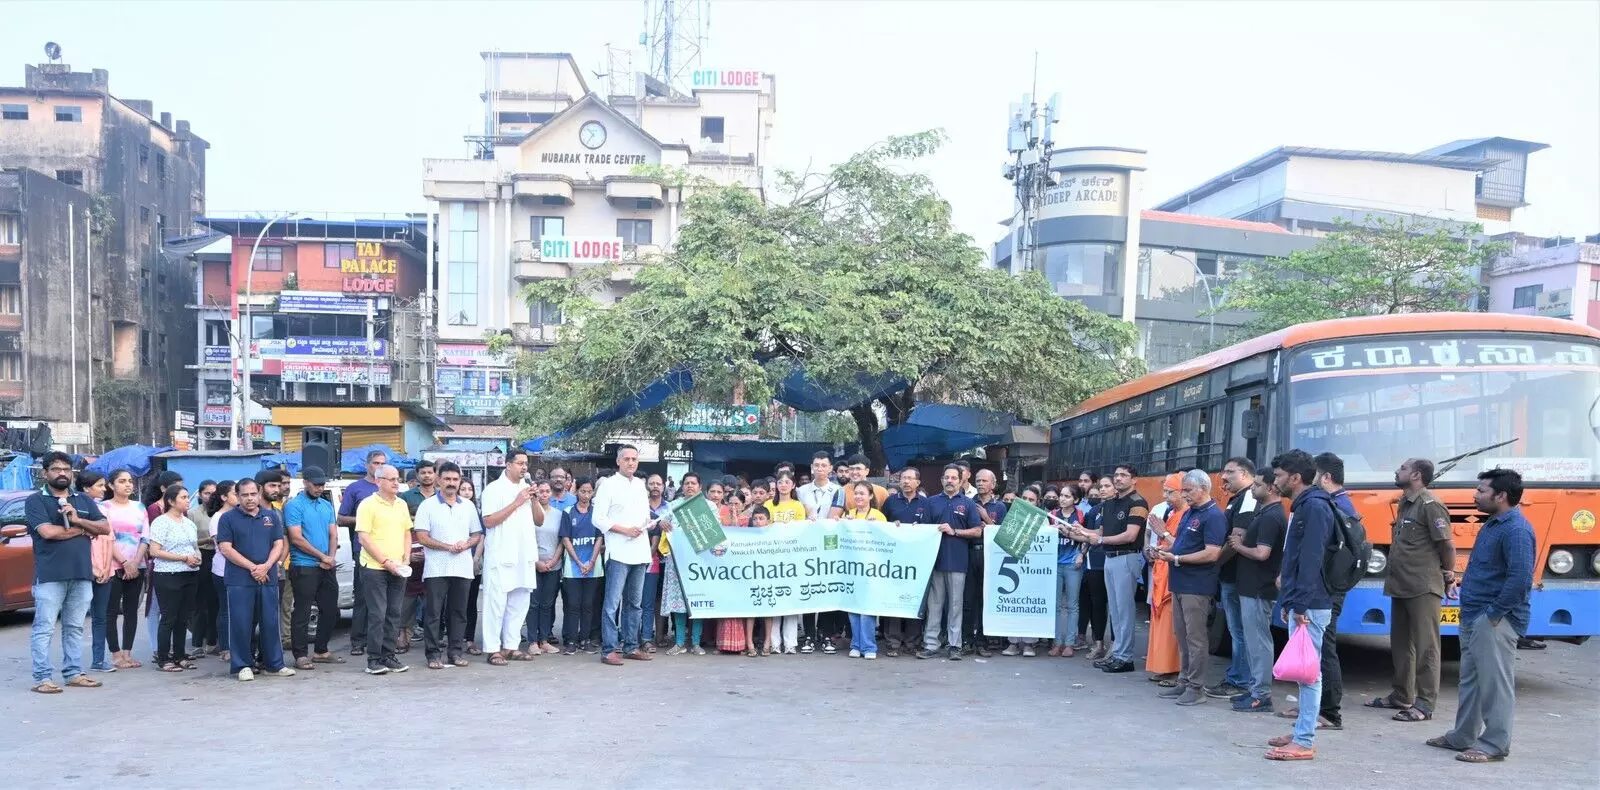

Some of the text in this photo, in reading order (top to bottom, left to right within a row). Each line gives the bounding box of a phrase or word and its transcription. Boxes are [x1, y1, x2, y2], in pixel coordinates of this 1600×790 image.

[693, 70, 759, 86] CITI LODGE
[541, 153, 646, 165] MUBARAK TRADE CENTRE
[1075, 189, 1118, 202] ARCADE
[356, 240, 381, 257] TAJ
[543, 240, 620, 258] CITI LODGE
[341, 258, 396, 274] PALACE
[342, 276, 394, 293] LODGE
[572, 537, 595, 546] NIPT
[1033, 535, 1051, 544] 024
[1060, 537, 1075, 546] IPT
[1030, 544, 1045, 552] AY
[688, 557, 918, 582] Swacchata Shramadan
[1020, 566, 1053, 575] Month
[750, 581, 855, 608] ಸ್ವಚ್ಛತಾ ಶ್ರಮದಾನ
[998, 595, 1047, 605] Swacchata
[690, 600, 715, 608] NITTE
[996, 604, 1048, 614] Shramadan
